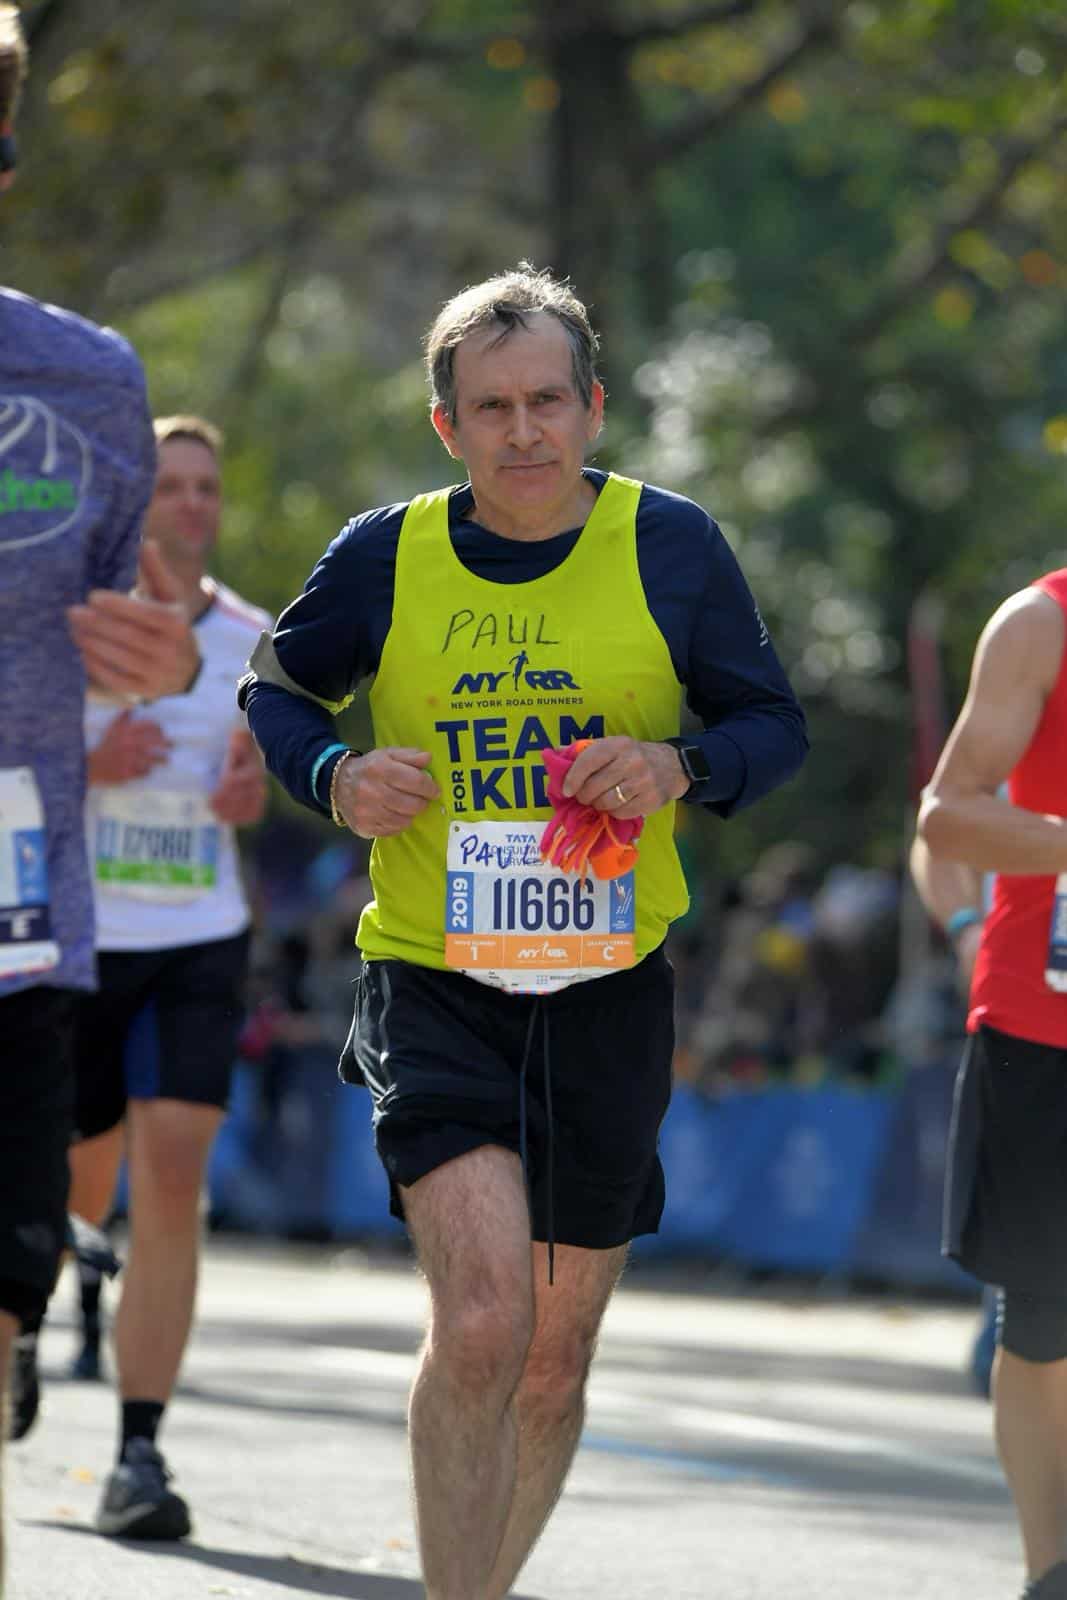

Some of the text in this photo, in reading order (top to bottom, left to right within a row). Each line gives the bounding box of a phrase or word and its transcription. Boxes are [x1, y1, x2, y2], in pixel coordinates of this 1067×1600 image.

[441, 608, 560, 653] PAUL
[450, 696, 584, 710] NEW YORK ROAD RUNNERS
[435, 715, 605, 763] TEAM
[451, 769, 467, 813] FOR
[460, 834, 543, 870] PAUL
[506, 834, 537, 844] TATA
[451, 877, 470, 929] 2019
[493, 877, 595, 932] 11666
[603, 946, 615, 961] C
